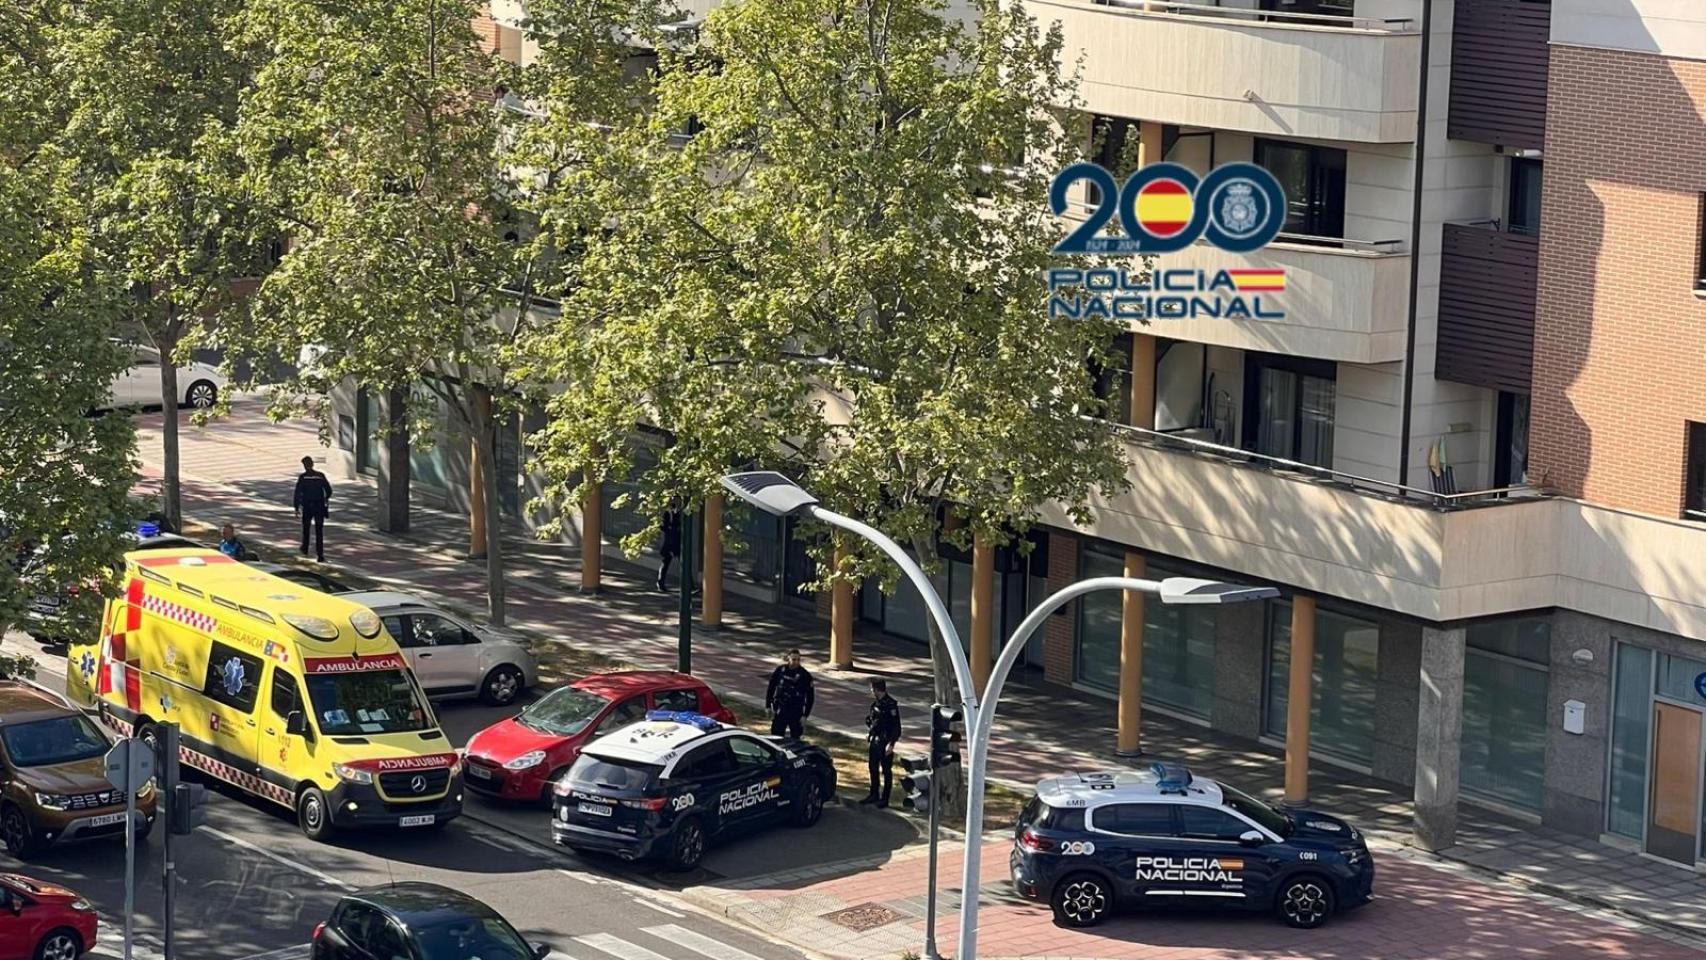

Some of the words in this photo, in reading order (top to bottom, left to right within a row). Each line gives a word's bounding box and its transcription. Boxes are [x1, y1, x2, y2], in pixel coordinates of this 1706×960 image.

[217, 624, 264, 649] AMBULANCIA
[316, 658, 400, 673] AMBULANCIA
[572, 791, 608, 804] POLICIA
[720, 780, 769, 804] POLICIA
[672, 792, 695, 811] 200
[718, 789, 780, 815] NACIONAL
[1060, 841, 1095, 856] 200
[1136, 857, 1221, 869] POLICIA
[1136, 869, 1243, 882] NACIONAL
